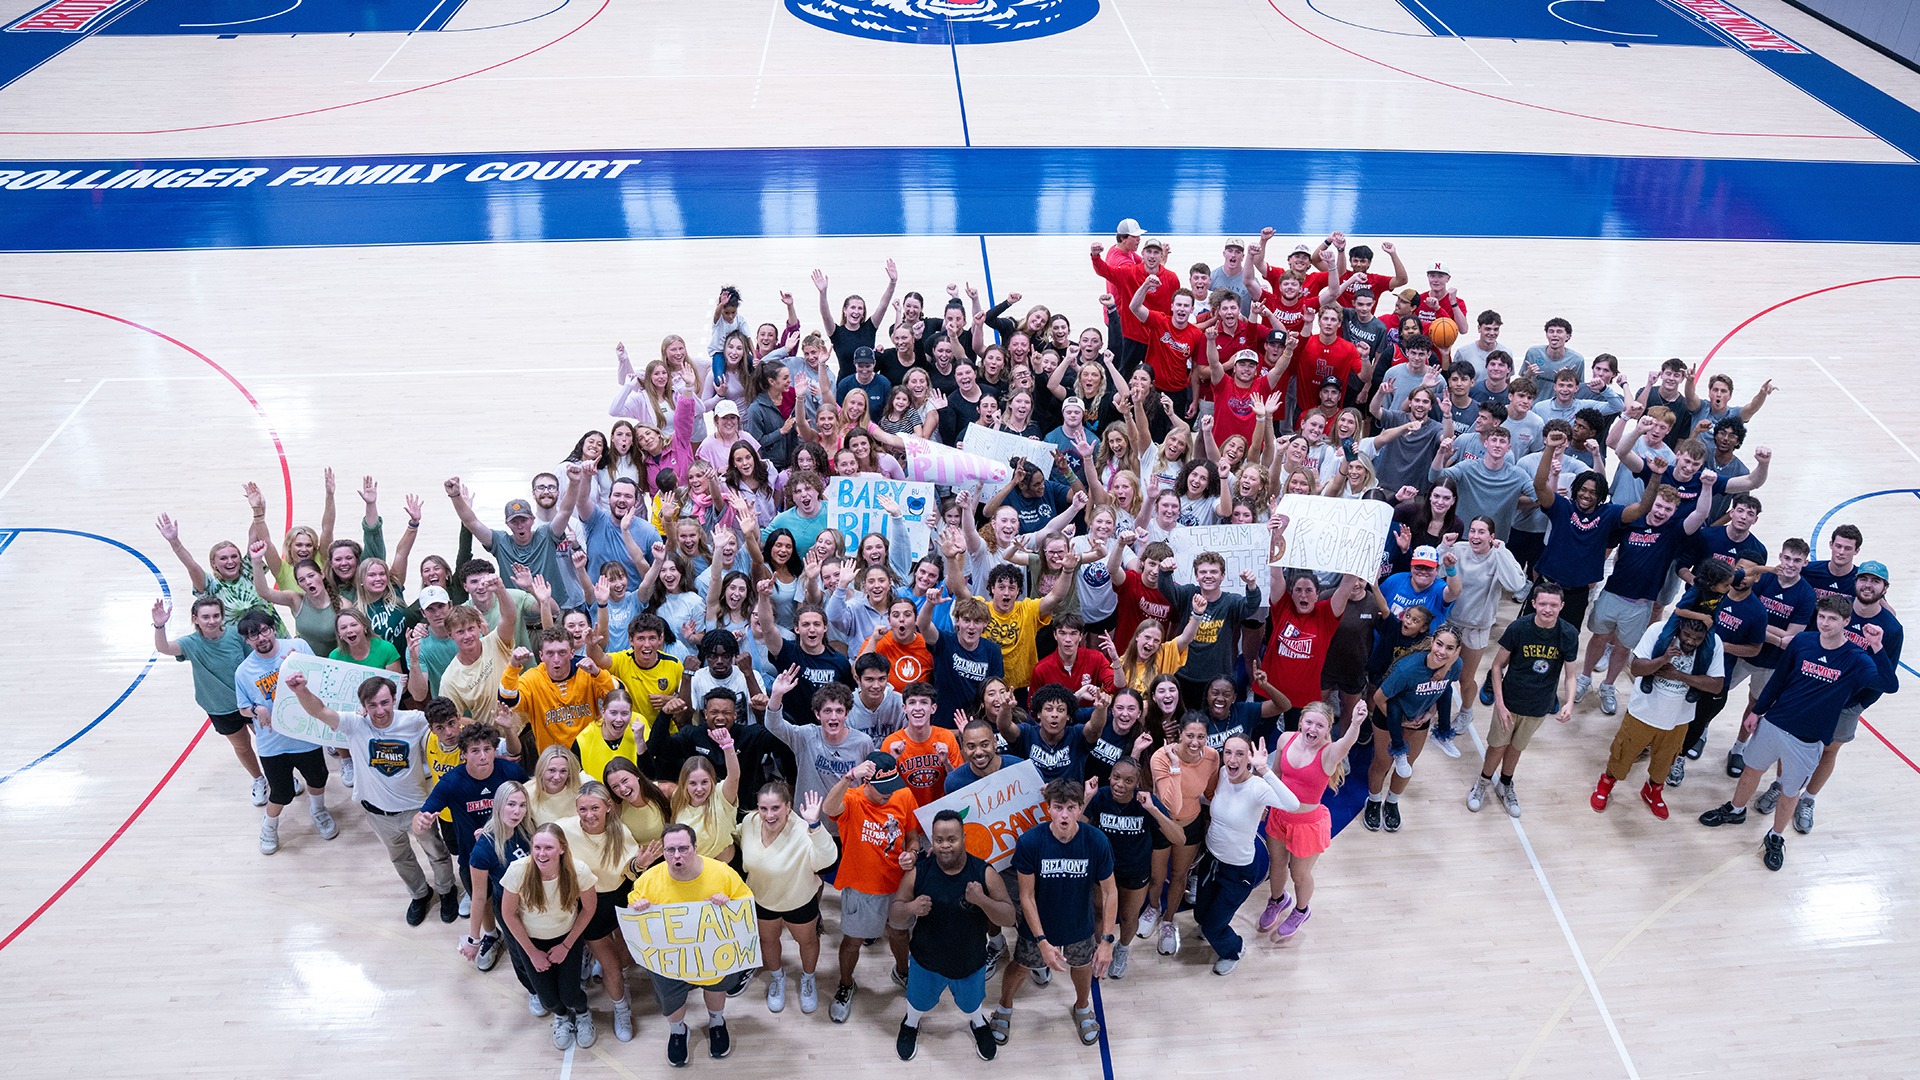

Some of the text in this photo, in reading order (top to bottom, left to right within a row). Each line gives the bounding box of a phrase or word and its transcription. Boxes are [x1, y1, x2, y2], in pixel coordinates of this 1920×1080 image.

[14, 0, 118, 29] BRU
[266, 163, 467, 187] FAMILY
[465, 159, 642, 182] COURT
[913, 453, 996, 485] PINK
[838, 479, 907, 510] BABY
[1286, 501, 1382, 534] TEAM
[1190, 525, 1252, 547] TEAM
[1172, 549, 1270, 588] WITE
[371, 601, 397, 630] Alph
[1139, 596, 1171, 619] BELMONT
[1198, 619, 1225, 630] URDAY
[1718, 611, 1743, 630] MONT
[952, 653, 988, 676] BELMONT
[1801, 660, 1841, 681] BELMONT
[287, 659, 401, 702] TEA
[1416, 679, 1449, 692] BELMONT
[277, 696, 364, 743] GREE
[546, 703, 592, 726] PREDATORS
[375, 750, 404, 761] TENNIS
[1029, 744, 1070, 767] BELMONT
[1096, 738, 1123, 760] ELMON
[433, 760, 456, 773] LAKE
[816, 754, 857, 773] BELMONT
[466, 799, 494, 813] BELMO
[961, 779, 1030, 819] Team
[477, 809, 493, 817] TENN
[1100, 812, 1144, 832] BELMONT
[861, 833, 884, 846] RUN!
[1040, 858, 1090, 874] BELMONT
[620, 899, 757, 945] TEAM
[626, 935, 758, 979] YELLOW
